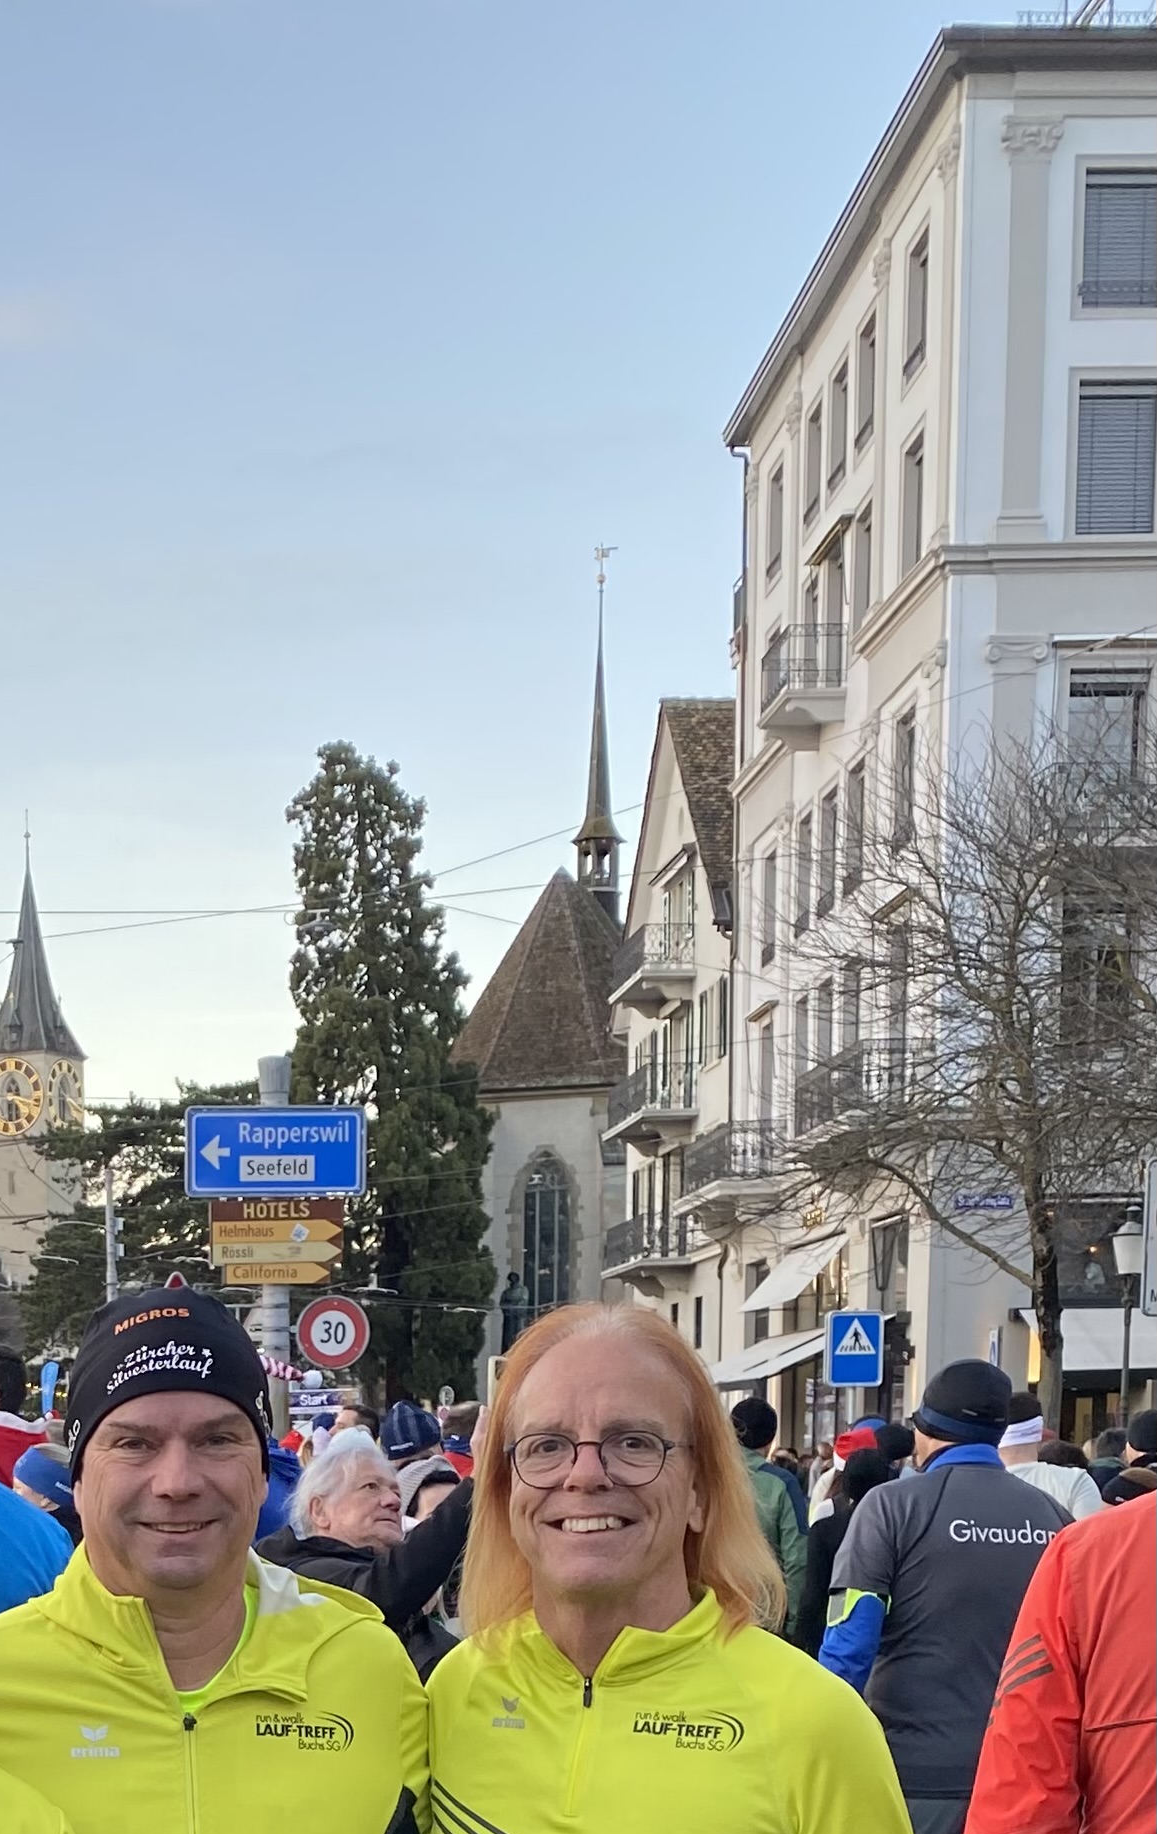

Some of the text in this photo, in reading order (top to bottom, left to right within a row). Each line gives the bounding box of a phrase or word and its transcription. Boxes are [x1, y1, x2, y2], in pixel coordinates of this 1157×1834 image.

[239, 1121, 349, 1149] Rapperswil
[246, 1158, 308, 1176] Seefeld
[243, 1202, 310, 1218] HOTELS
[219, 1225, 274, 1237] Helmhaus
[221, 1245, 254, 1258] Rössli
[233, 1267, 298, 1279] California
[114, 1307, 190, 1335] MIGROS
[320, 1321, 345, 1344] 30
[125, 1340, 196, 1368] Zürcher
[106, 1356, 213, 1395] Silvesterlauf
[299, 1393, 328, 1406] Start
[256, 1714, 272, 1723] run
[281, 1712, 304, 1724] walk
[635, 1712, 652, 1721] run
[662, 1710, 687, 1722] walk
[255, 1723, 337, 1740] LAUF-TREFF
[632, 1720, 724, 1739] LAUF-TREFF
[70, 1745, 120, 1758] erima
[298, 1739, 341, 1751] Buchs SG
[675, 1737, 725, 1752] Buchs SG
